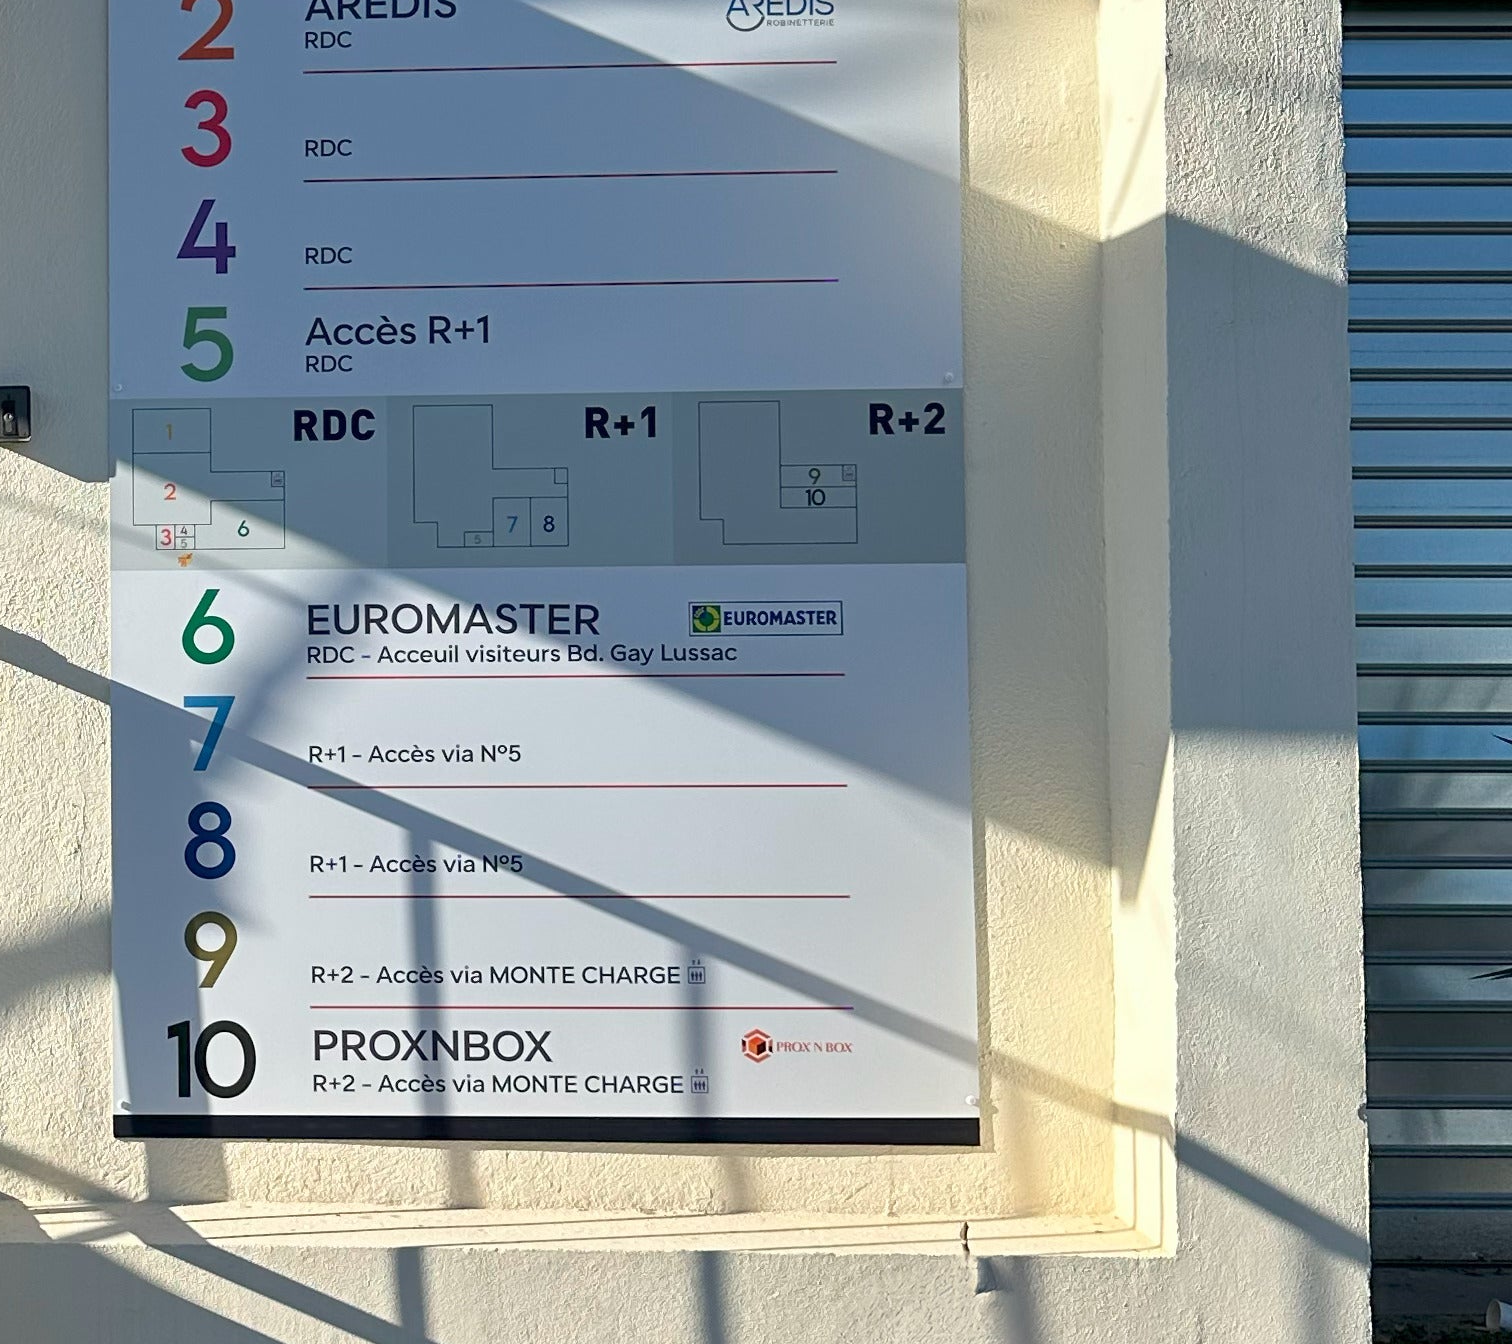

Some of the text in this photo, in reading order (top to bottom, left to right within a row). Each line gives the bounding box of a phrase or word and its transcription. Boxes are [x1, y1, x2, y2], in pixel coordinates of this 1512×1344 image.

[766, 18, 835, 27] ROBINETTERIE
[304, 30, 352, 50] RDC
[180, 89, 232, 168] 3
[304, 138, 353, 158] RDC
[176, 198, 237, 275] 4
[305, 246, 353, 265] RDC
[305, 314, 489, 347] Accès R+1
[180, 306, 234, 383] 5
[305, 354, 353, 373] RDC
[293, 408, 376, 442] RDC
[585, 406, 656, 439] R+1
[869, 402, 946, 435] R+2
[166, 423, 173, 441] 1
[808, 468, 821, 485] 9
[163, 483, 177, 501] 2
[805, 489, 826, 507] 10
[180, 525, 188, 536] 4
[237, 520, 250, 537] 6
[507, 516, 518, 533] 7
[543, 515, 555, 533] 8
[160, 528, 172, 546] 3
[180, 538, 188, 549] 5
[474, 534, 481, 545] 5
[181, 588, 236, 665] 6
[307, 603, 600, 636] EUROMASTER
[724, 610, 837, 626] EUROMASTER
[307, 645, 355, 664] RDC
[377, 644, 459, 664] Acceuil
[465, 644, 561, 663] visiteurs
[567, 643, 604, 662] Bd.
[610, 643, 655, 667] Gay
[661, 643, 738, 662] Lussac
[181, 695, 237, 771] 7
[308, 745, 346, 763] R+1
[368, 744, 436, 763] Accès
[441, 744, 474, 763] via
[183, 801, 237, 880] 8
[310, 855, 347, 873] R+1
[369, 854, 437, 873] Accès
[442, 854, 477, 873] via
[183, 910, 238, 989] 9
[311, 965, 354, 984] R+2
[376, 965, 444, 984] Accès
[450, 965, 483, 984] via
[489, 965, 576, 984] MONTE
[581, 965, 681, 985] CHARGE
[313, 1029, 553, 1063] PROXNBOX
[776, 1041, 853, 1053] PROX N BOX
[167, 1019, 257, 1099] 10
[312, 1074, 356, 1093] R+2
[377, 1073, 446, 1093] Accès
[452, 1073, 485, 1093] via
[492, 1074, 578, 1094] MONTE
[584, 1075, 684, 1094] CHARGE
